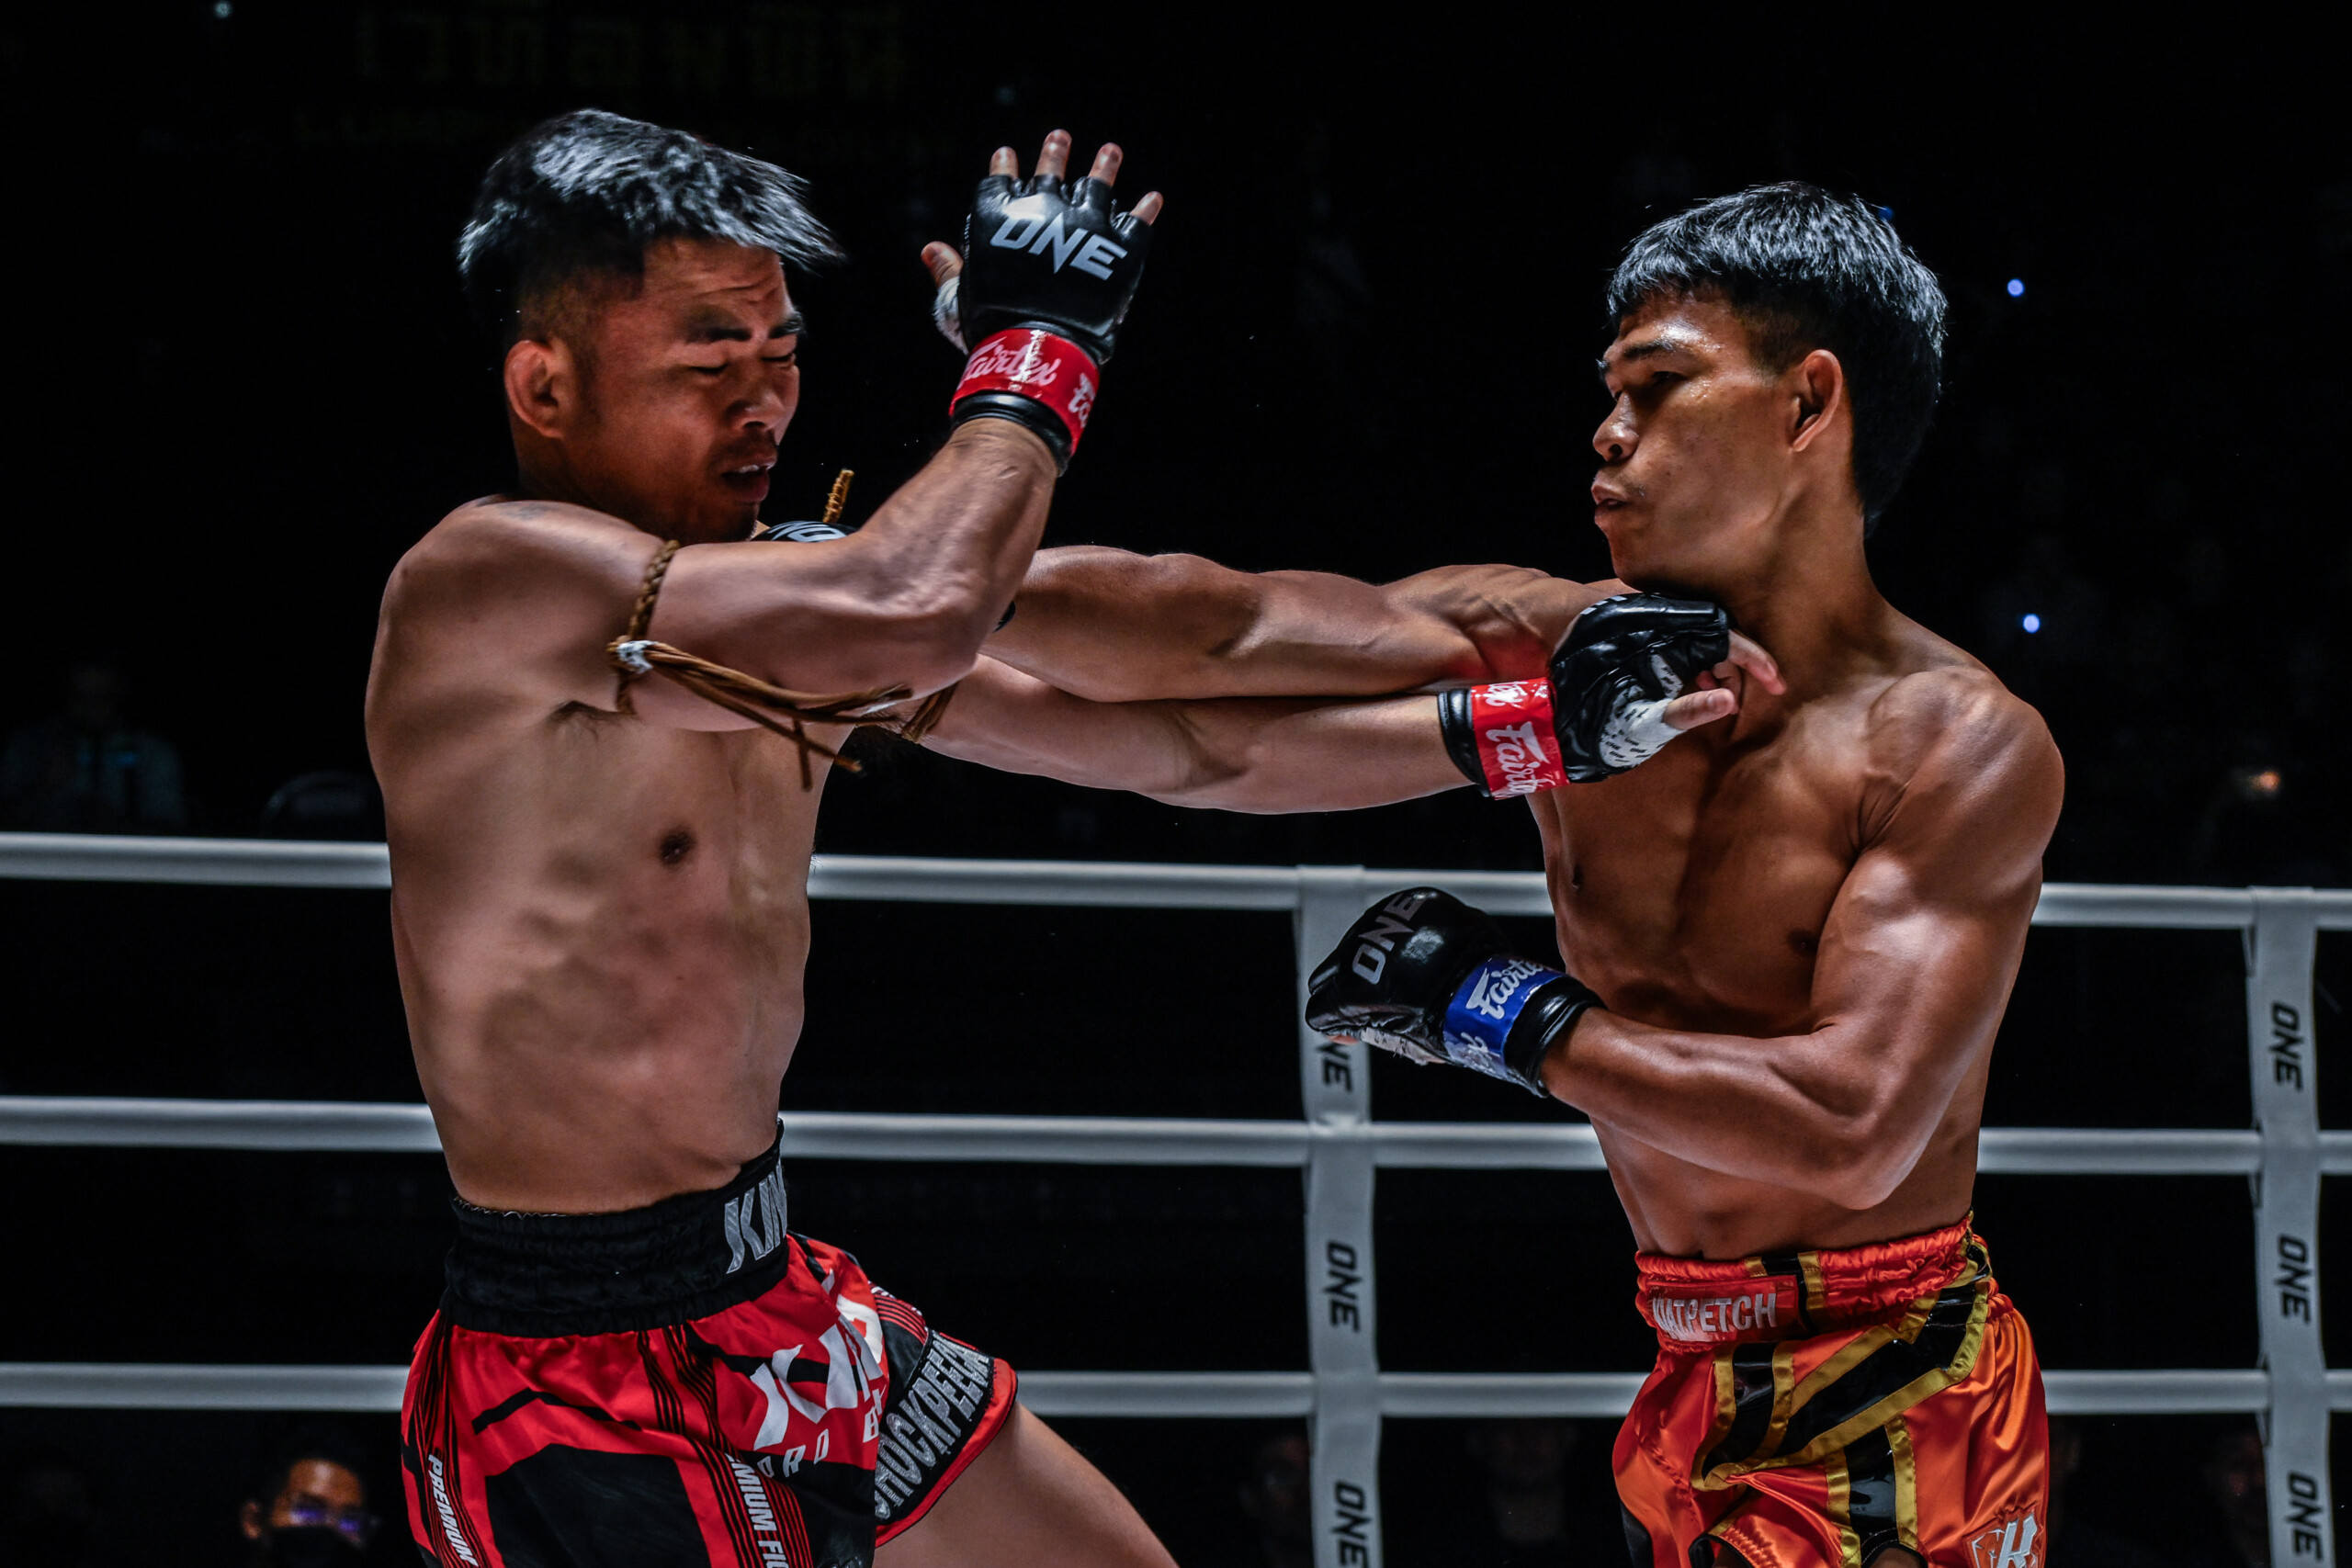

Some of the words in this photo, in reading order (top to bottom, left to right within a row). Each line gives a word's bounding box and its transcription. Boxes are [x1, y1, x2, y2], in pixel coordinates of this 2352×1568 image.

[990, 212, 1128, 281] ONE
[956, 336, 1062, 391] Fairtex
[1351, 892, 1424, 986] ONE
[1465, 959, 1544, 1020] Fairte
[1314, 1040, 1353, 1093] NE
[2270, 1001, 2303, 1091] ONE
[1323, 1239, 1361, 1334] ONE
[2275, 1234, 2311, 1325] ONE
[428, 1453, 480, 1567] PREMIUM
[1332, 1480, 1369, 1568] ONE
[2286, 1470, 2324, 1562] ONE
